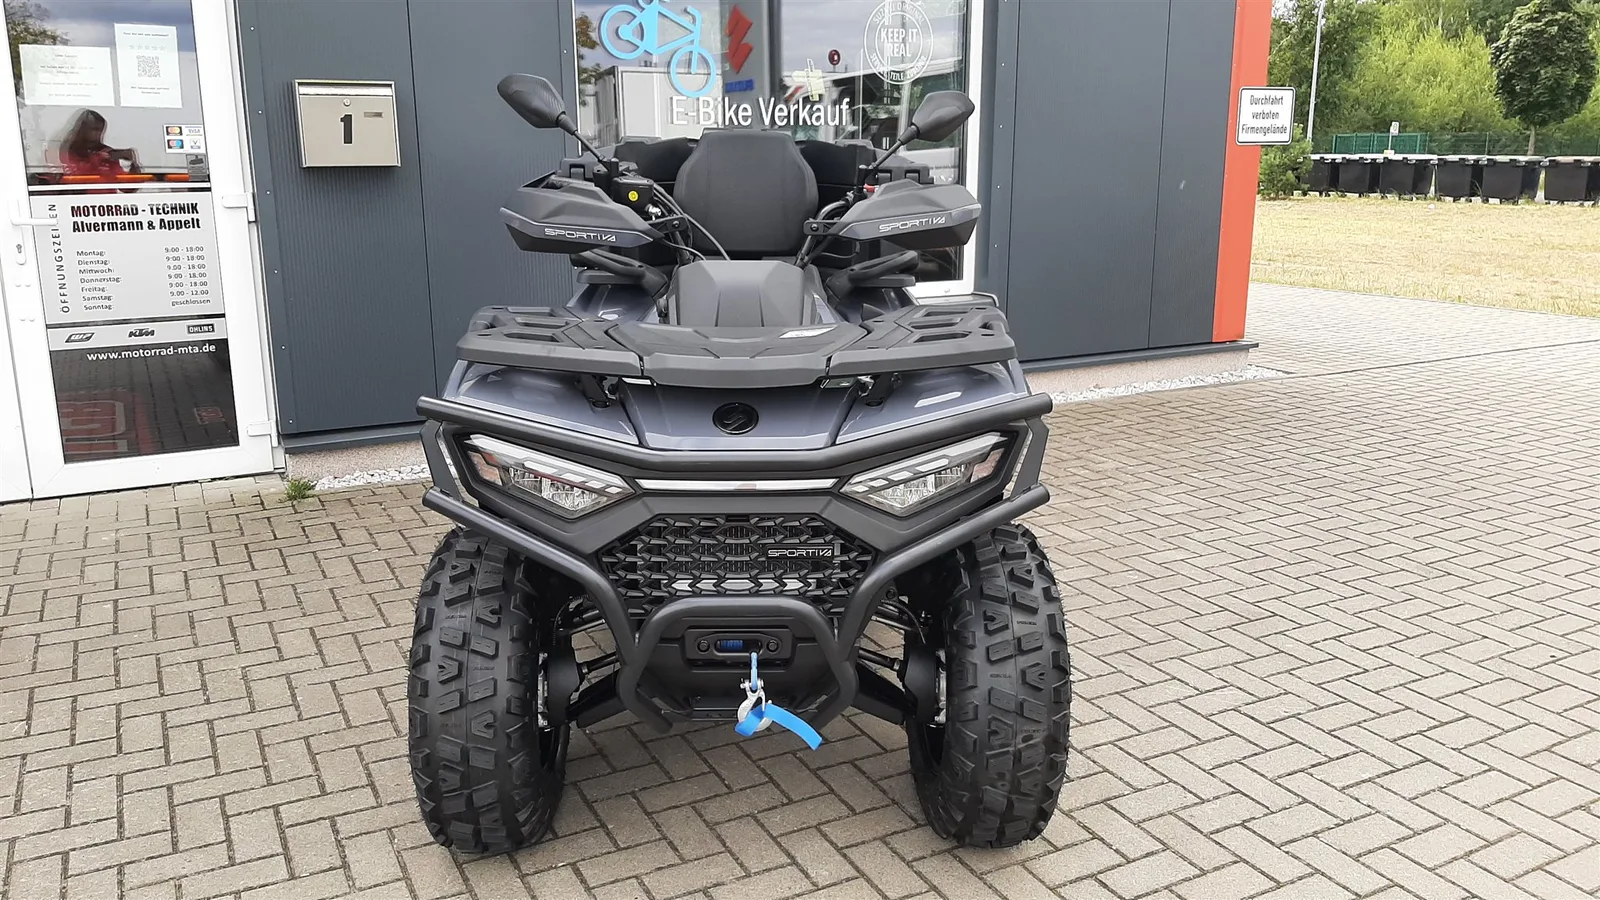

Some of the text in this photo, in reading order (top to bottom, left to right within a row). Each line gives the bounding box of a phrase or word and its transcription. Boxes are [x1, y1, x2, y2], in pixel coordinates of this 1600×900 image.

[880, 28, 918, 43] KEEP IT
[888, 43, 912, 57] REAL
[1250, 95, 1284, 106] Durchfahrt
[672, 96, 850, 126] E-Bike Verkauf
[1252, 110, 1280, 120] verboten
[340, 113, 353, 145] 1
[1241, 124, 1288, 137] Firmengelände
[70, 205, 139, 218] MOTORRAD
[148, 202, 200, 216] TECHNIK
[72, 217, 201, 233] Alvermann & Appelt
[879, 216, 946, 233] SPORTIVA
[544, 227, 616, 242] SPORTIVA
[48, 203, 70, 314] ÖFFNUNGSZEIEN
[128, 327, 155, 338] KTM
[86, 343, 216, 361] www.motorrad-mta.de
[767, 549, 832, 557] SPORTIVA
